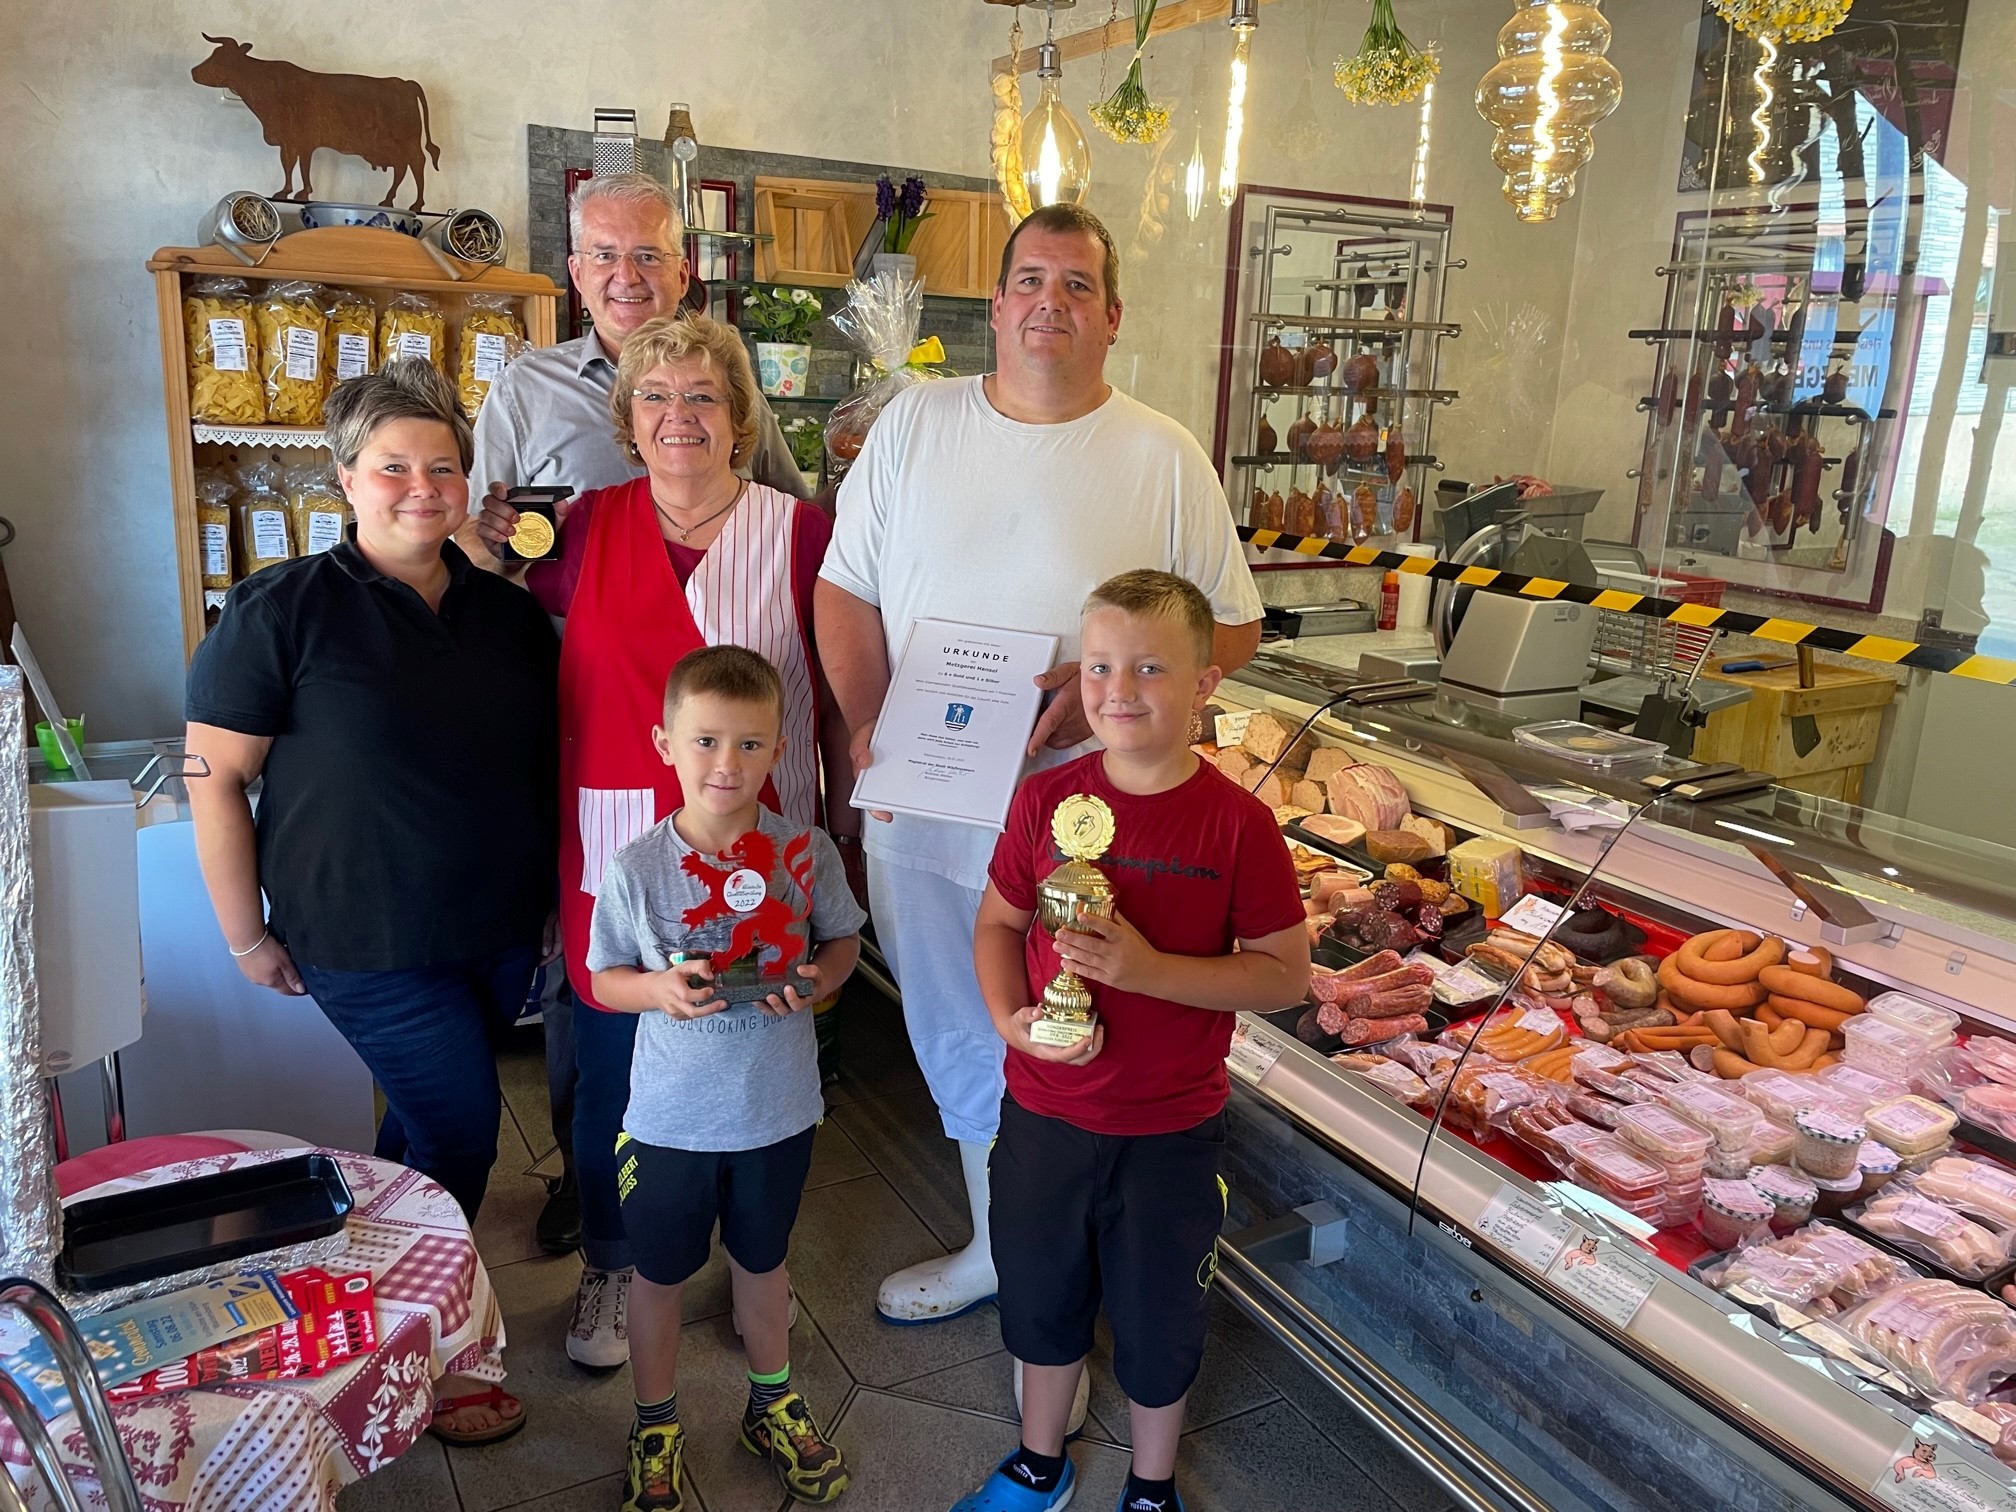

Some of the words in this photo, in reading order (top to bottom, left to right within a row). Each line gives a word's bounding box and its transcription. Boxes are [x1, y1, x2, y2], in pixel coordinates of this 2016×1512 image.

[943, 646, 1009, 662] URKUNDE
[946, 661, 976, 669] Metzgerei
[735, 899, 756, 908] 2022
[699, 1015, 757, 1034] LOOKING
[146, 1319, 168, 1349] Samstag
[343, 1309, 364, 1355] WKKW
[115, 1317, 153, 1367] Sommerfest
